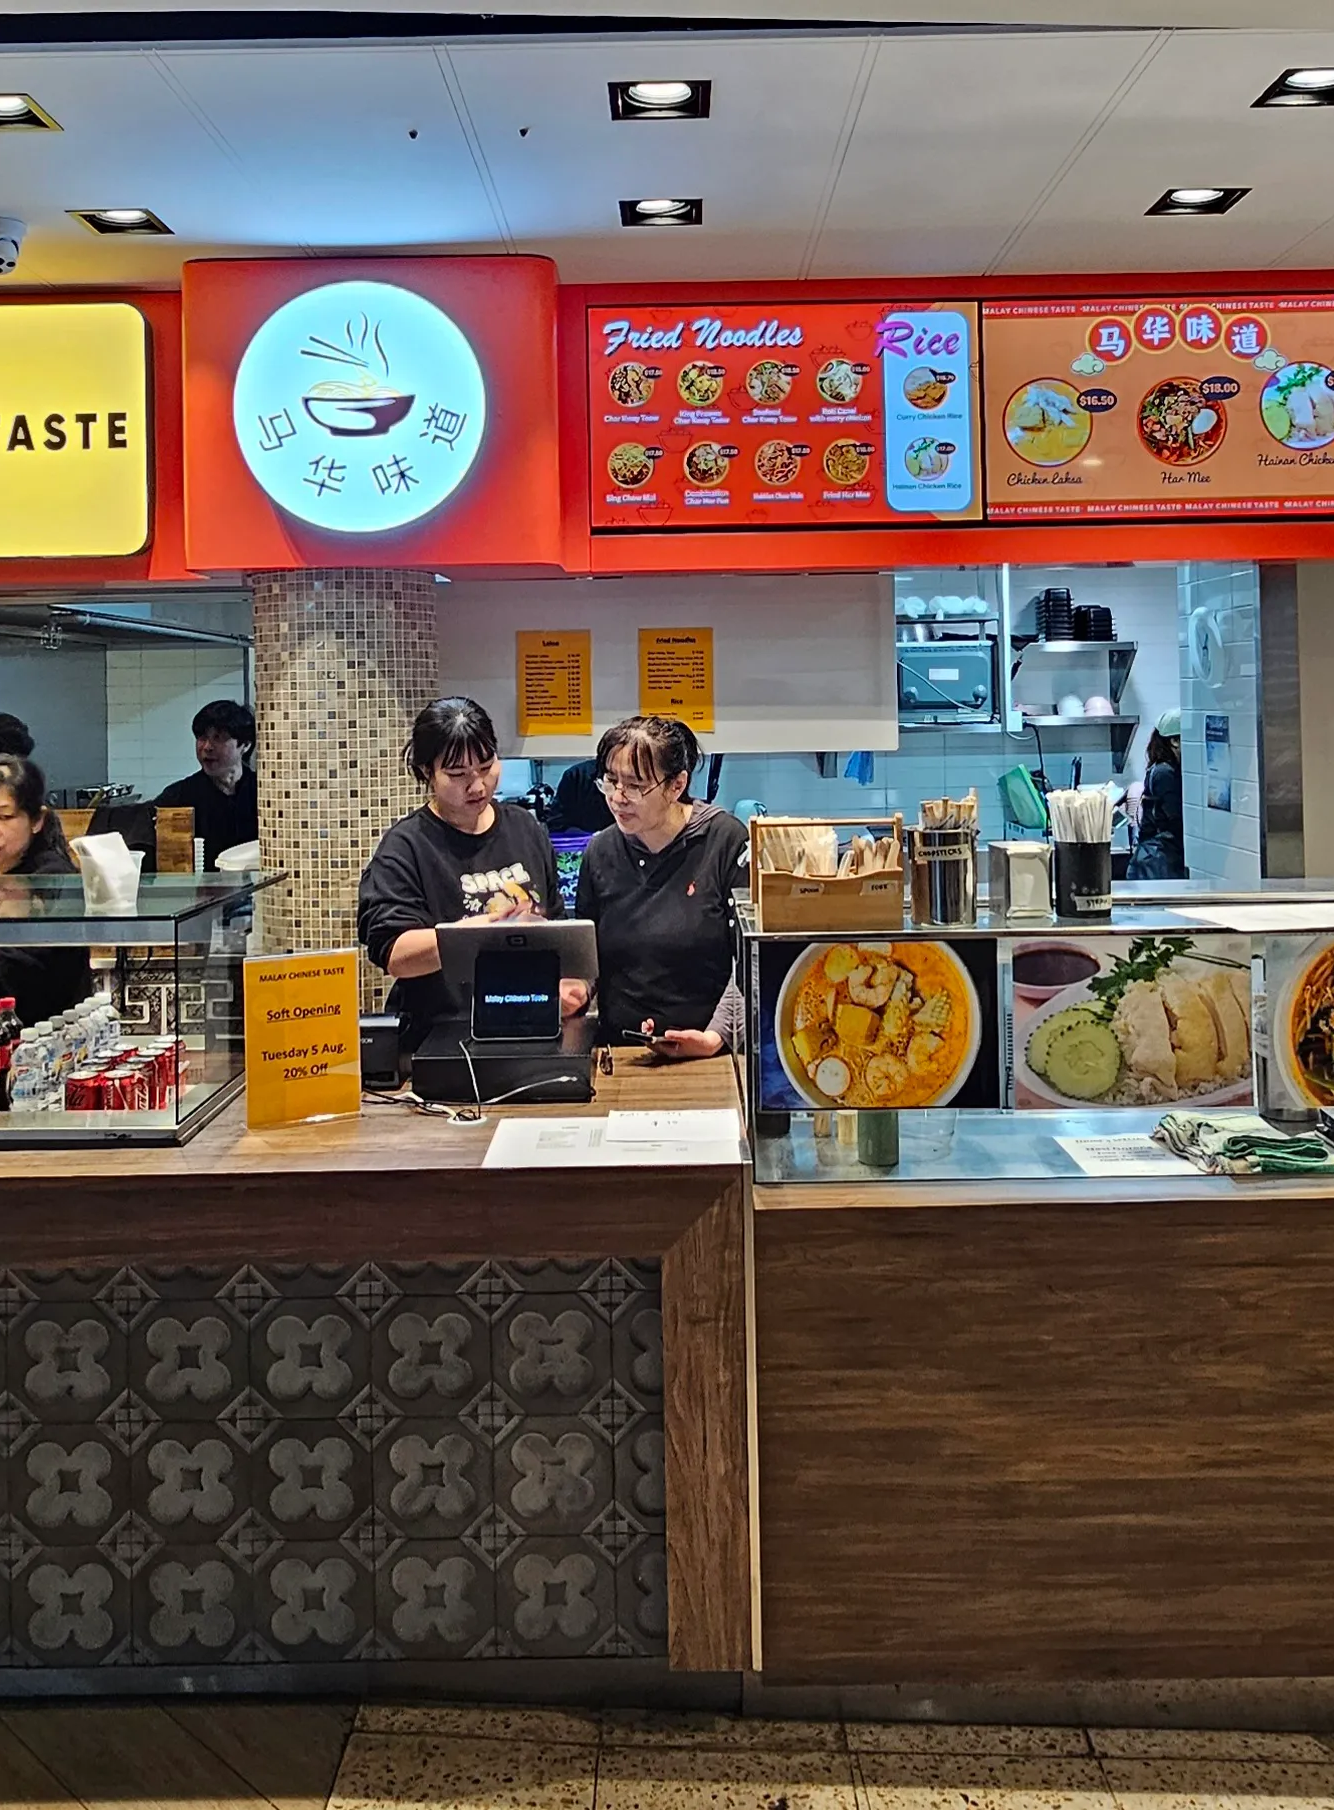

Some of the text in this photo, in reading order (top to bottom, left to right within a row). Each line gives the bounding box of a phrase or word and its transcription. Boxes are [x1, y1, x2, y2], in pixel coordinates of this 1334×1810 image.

[1013, 306, 1048, 314] CHINESE
[603, 317, 804, 356] Fried Noodles
[873, 320, 961, 359] Rice
[1095, 314, 1260, 357] 马华味道
[1202, 382, 1238, 394] $18.00
[1079, 394, 1114, 406] $16.50
[1257, 454, 1297, 467] Hainan
[1007, 473, 1049, 486] Chicken
[1161, 471, 1212, 484] Har Mee
[1017, 506, 1053, 514] CHINESE
[1118, 504, 1154, 512] CHINESE
[1215, 502, 1252, 510] CHINESE
[1254, 501, 1279, 509] TASTE
[918, 847, 962, 857] CHOPSTICKS
[259, 967, 345, 982] MALAY CHINESE TASTE
[267, 1004, 341, 1021] Soft Opening
[261, 1043, 347, 1062] Tuesday 5 Aug.
[283, 1063, 328, 1079] 20% Off
